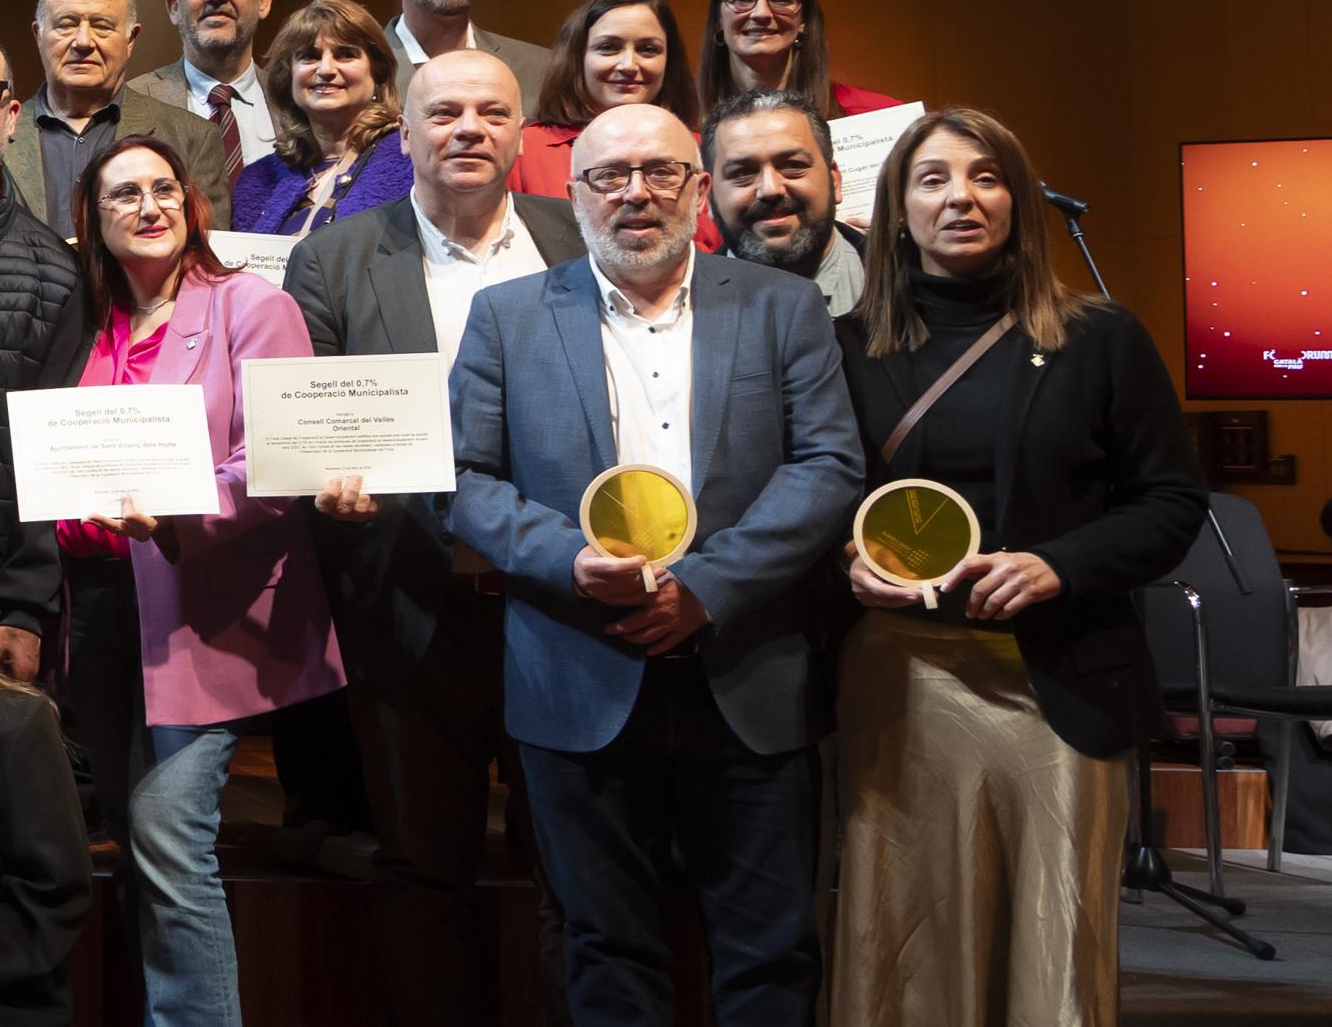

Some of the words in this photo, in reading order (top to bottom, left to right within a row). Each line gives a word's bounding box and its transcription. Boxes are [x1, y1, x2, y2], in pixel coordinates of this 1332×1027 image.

[837, 136, 893, 151] Municipalista
[250, 253, 275, 263] Segell
[310, 380, 337, 390] Segell
[294, 389, 346, 399] Cooperació
[348, 388, 409, 397] Municipalista
[113, 416, 170, 424] Municipalista
[325, 417, 359, 425] Comarcal
